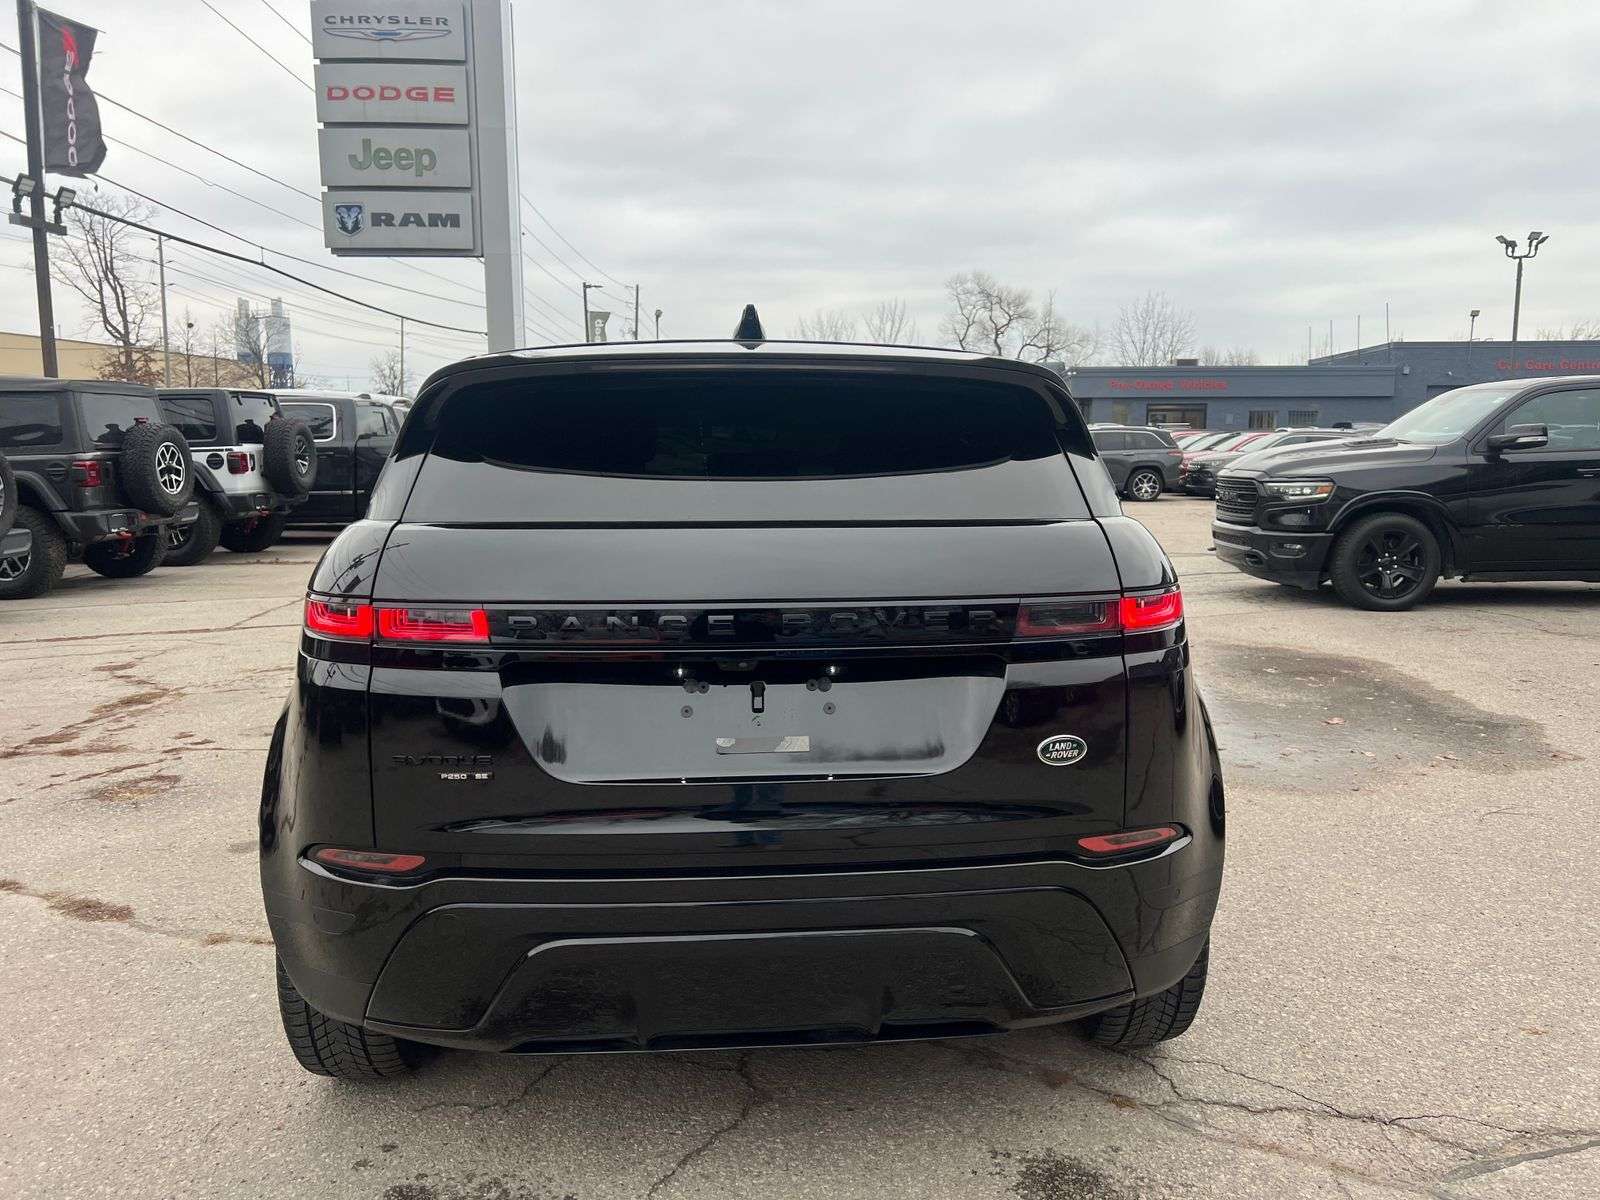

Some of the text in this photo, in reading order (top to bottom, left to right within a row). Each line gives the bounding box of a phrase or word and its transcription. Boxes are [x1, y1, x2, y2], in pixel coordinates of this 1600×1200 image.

[324, 15, 450, 26] CHRYSLER
[327, 86, 455, 103] DODGE
[348, 138, 438, 177] Jeep
[371, 212, 461, 228] RAM
[508, 610, 1001, 635] RANGE ROVER
[1049, 741, 1072, 751] LAND
[1050, 749, 1079, 759] ROVER
